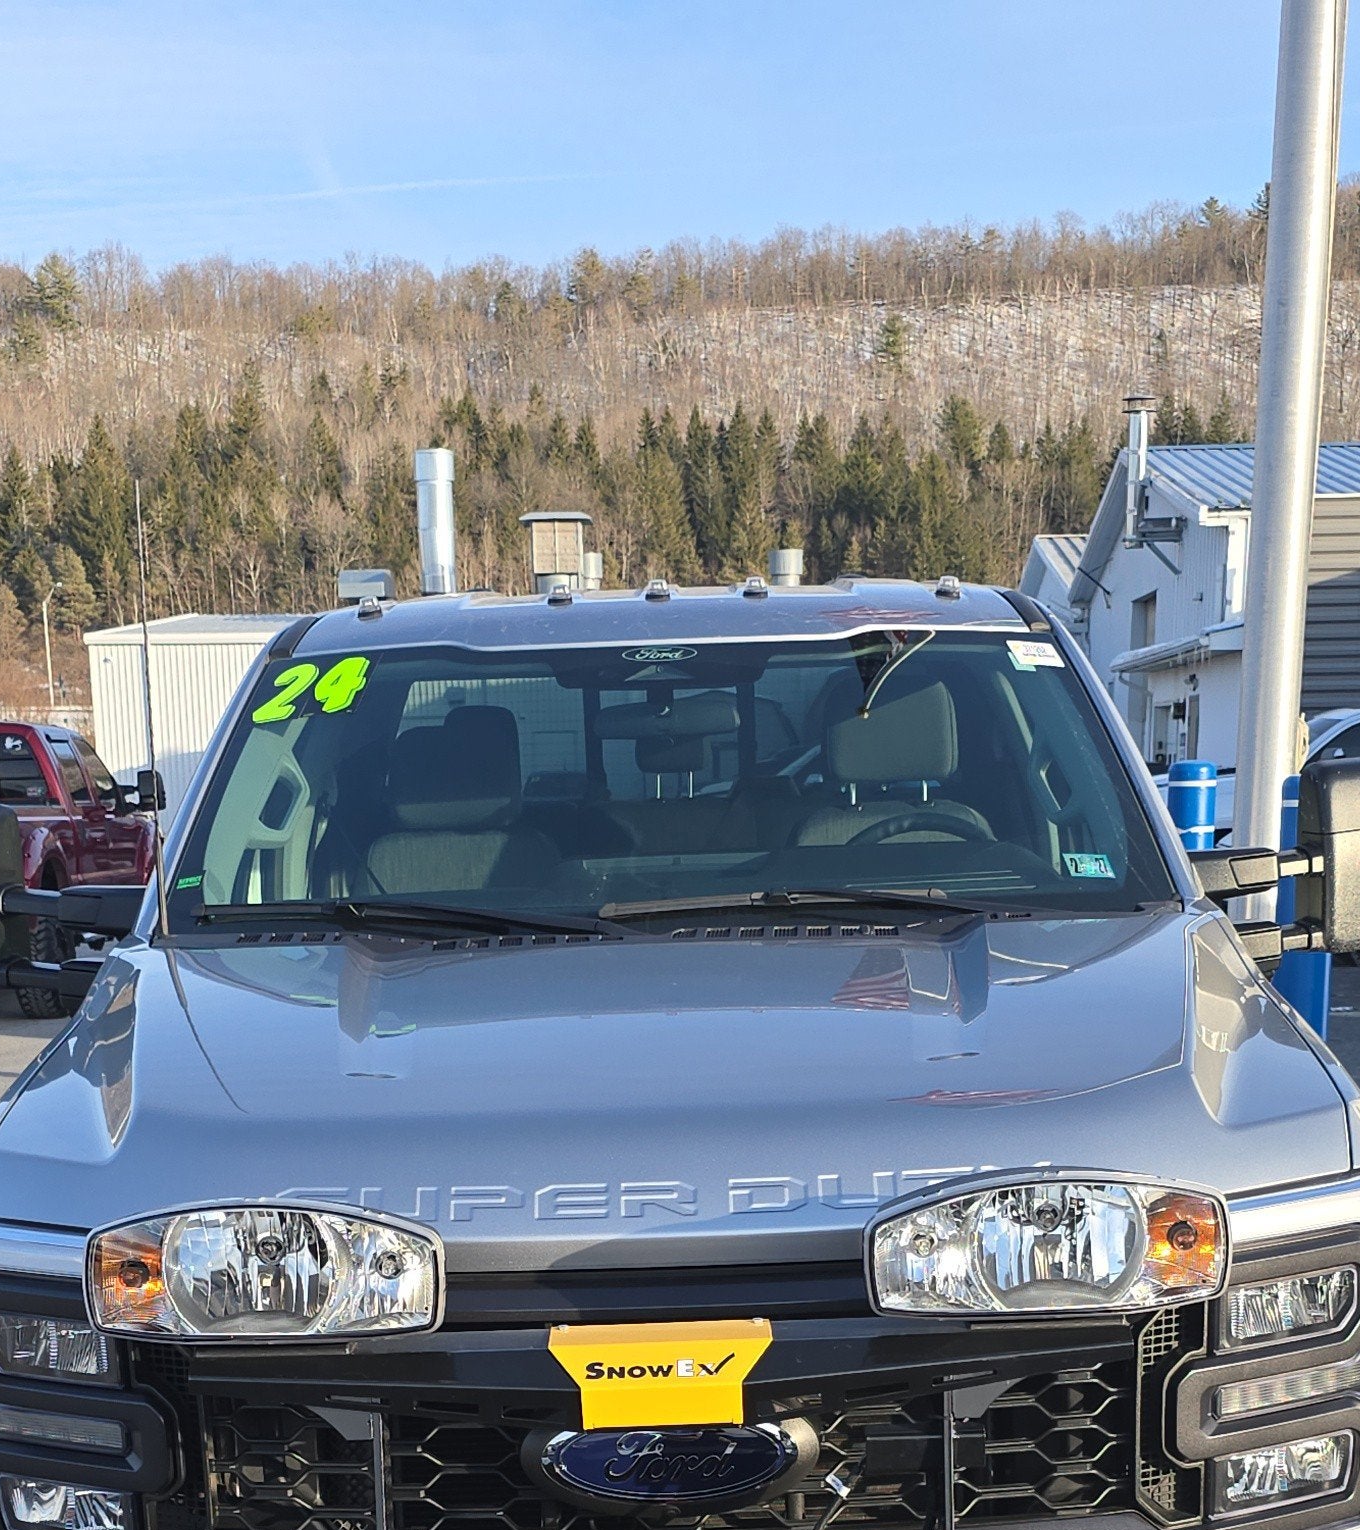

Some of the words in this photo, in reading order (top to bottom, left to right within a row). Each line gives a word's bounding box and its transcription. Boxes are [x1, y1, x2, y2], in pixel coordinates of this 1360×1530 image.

[635, 648, 684, 659] Ford
[252, 656, 370, 723] 24
[604, 1430, 737, 1484] Ford
